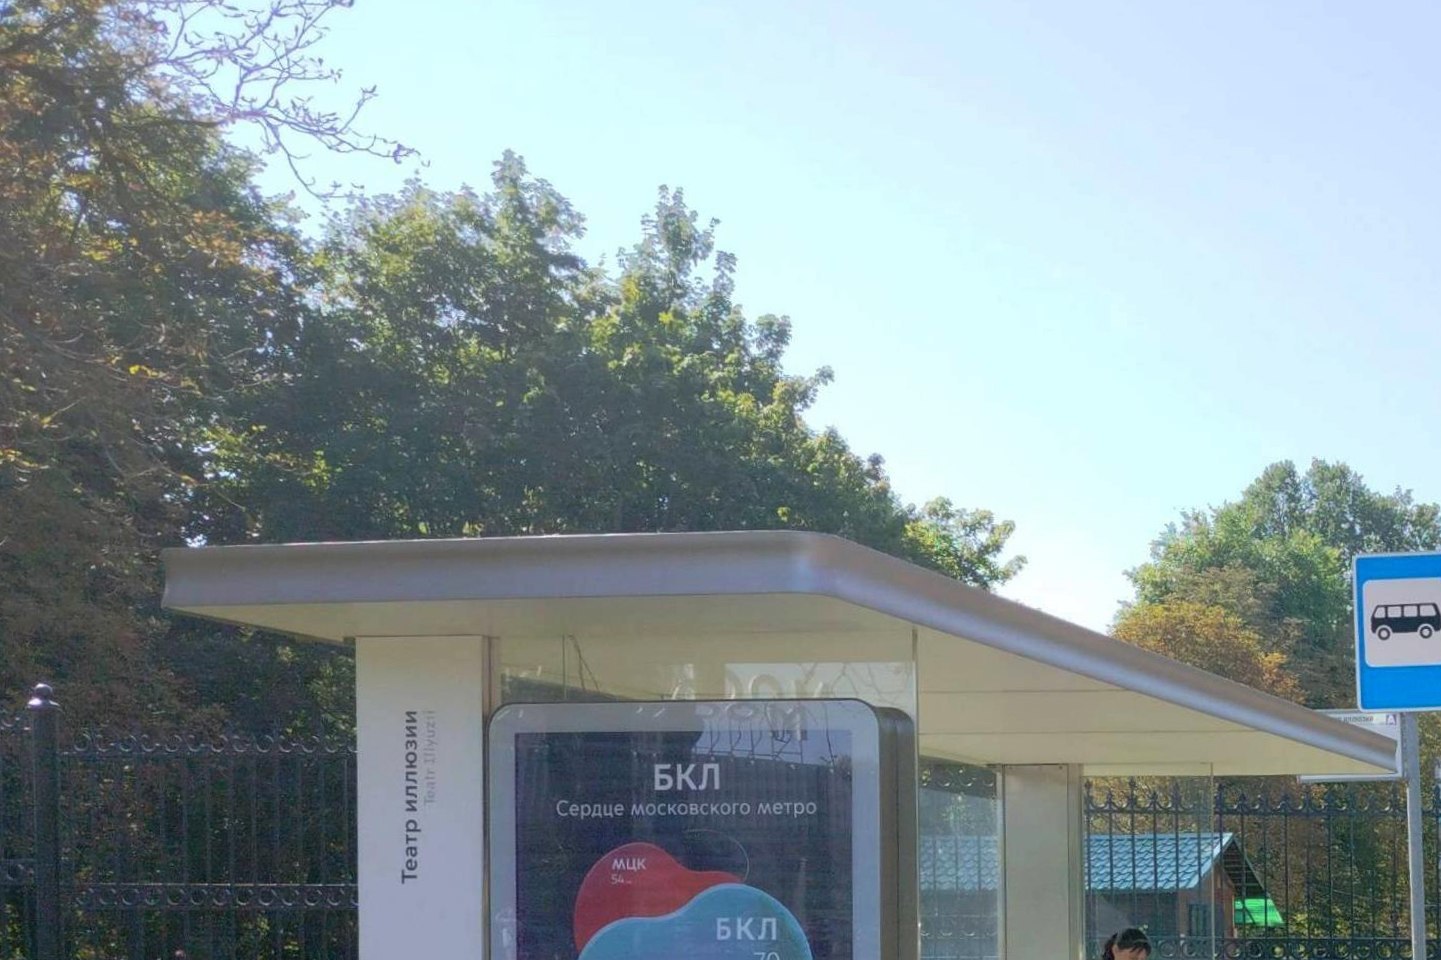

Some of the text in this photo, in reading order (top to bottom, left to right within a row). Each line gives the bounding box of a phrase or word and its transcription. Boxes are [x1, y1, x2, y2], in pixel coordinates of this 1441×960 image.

[653, 763, 721, 791] БКЛ
[402, 711, 421, 884] Театр иллюзии
[556, 800, 818, 820] Сердце московского метро
[612, 858, 647, 872] МЦК
[716, 917, 777, 941] БКЛ
